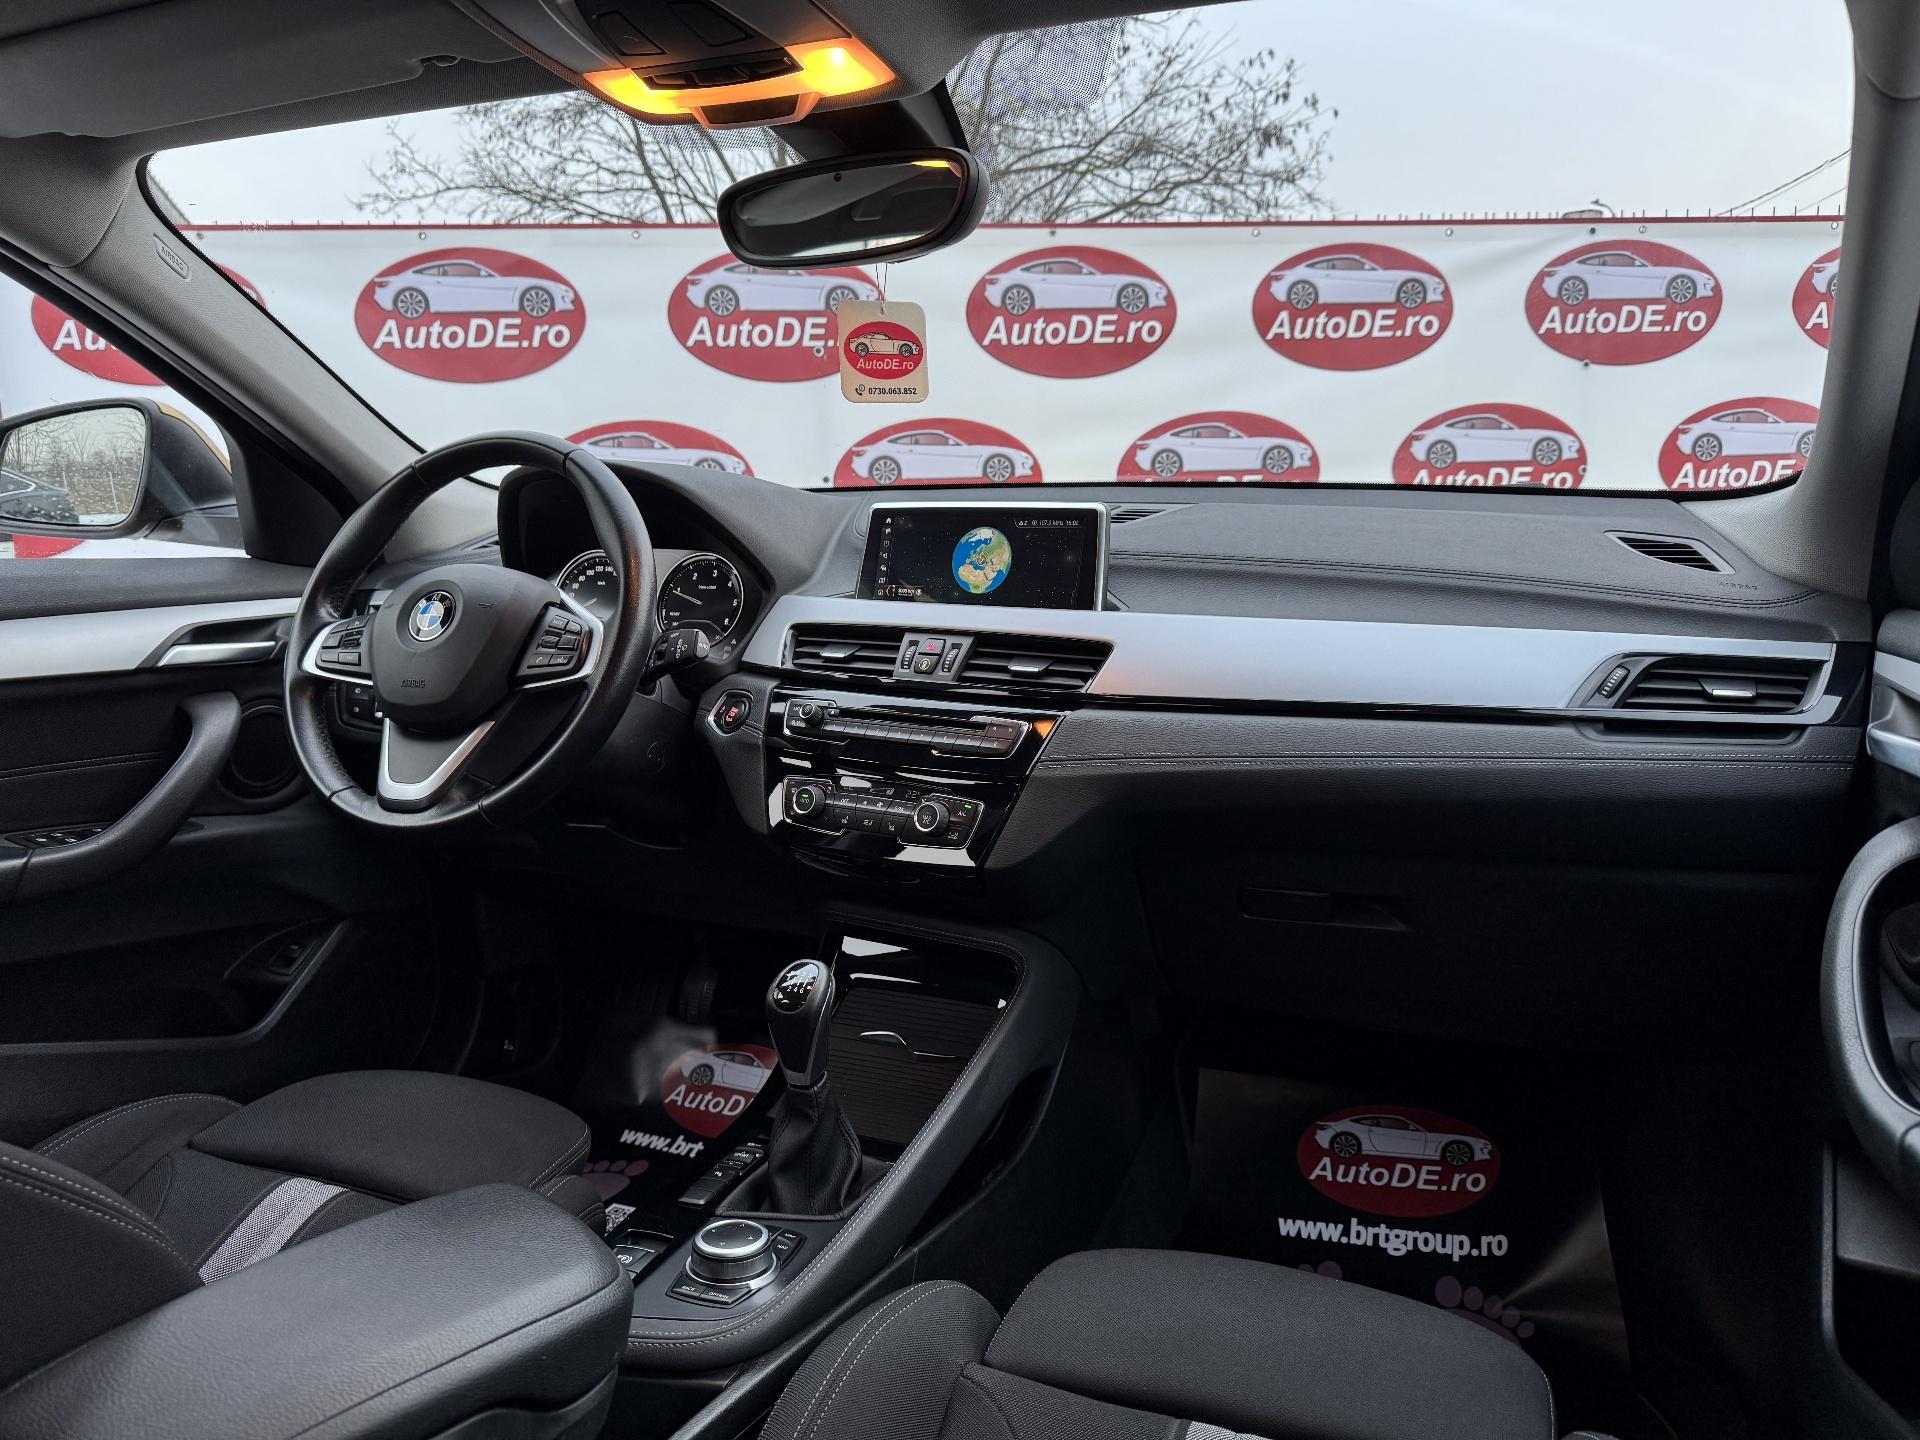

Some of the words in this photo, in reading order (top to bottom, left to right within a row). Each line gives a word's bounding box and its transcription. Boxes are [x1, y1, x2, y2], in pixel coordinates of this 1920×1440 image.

[373, 317, 571, 349] AutoDE.ro
[686, 316, 839, 348] AutoDE.
[982, 314, 1163, 346] AutoDE.ro
[1265, 309, 1440, 340] AutoDE.ro
[1538, 305, 1707, 335] AutoDE.ro
[857, 358, 914, 370] AutoDE.ro
[868, 387, 917, 395] 0730.063.852
[1413, 466, 1573, 489] AutoDEro
[402, 679, 426, 688] AIRBAG
[664, 1084, 753, 1116] AutoD
[1308, 1156, 1487, 1192] AutoDE.ro
[1277, 1217, 1509, 1262] www.brtgroup.ro
